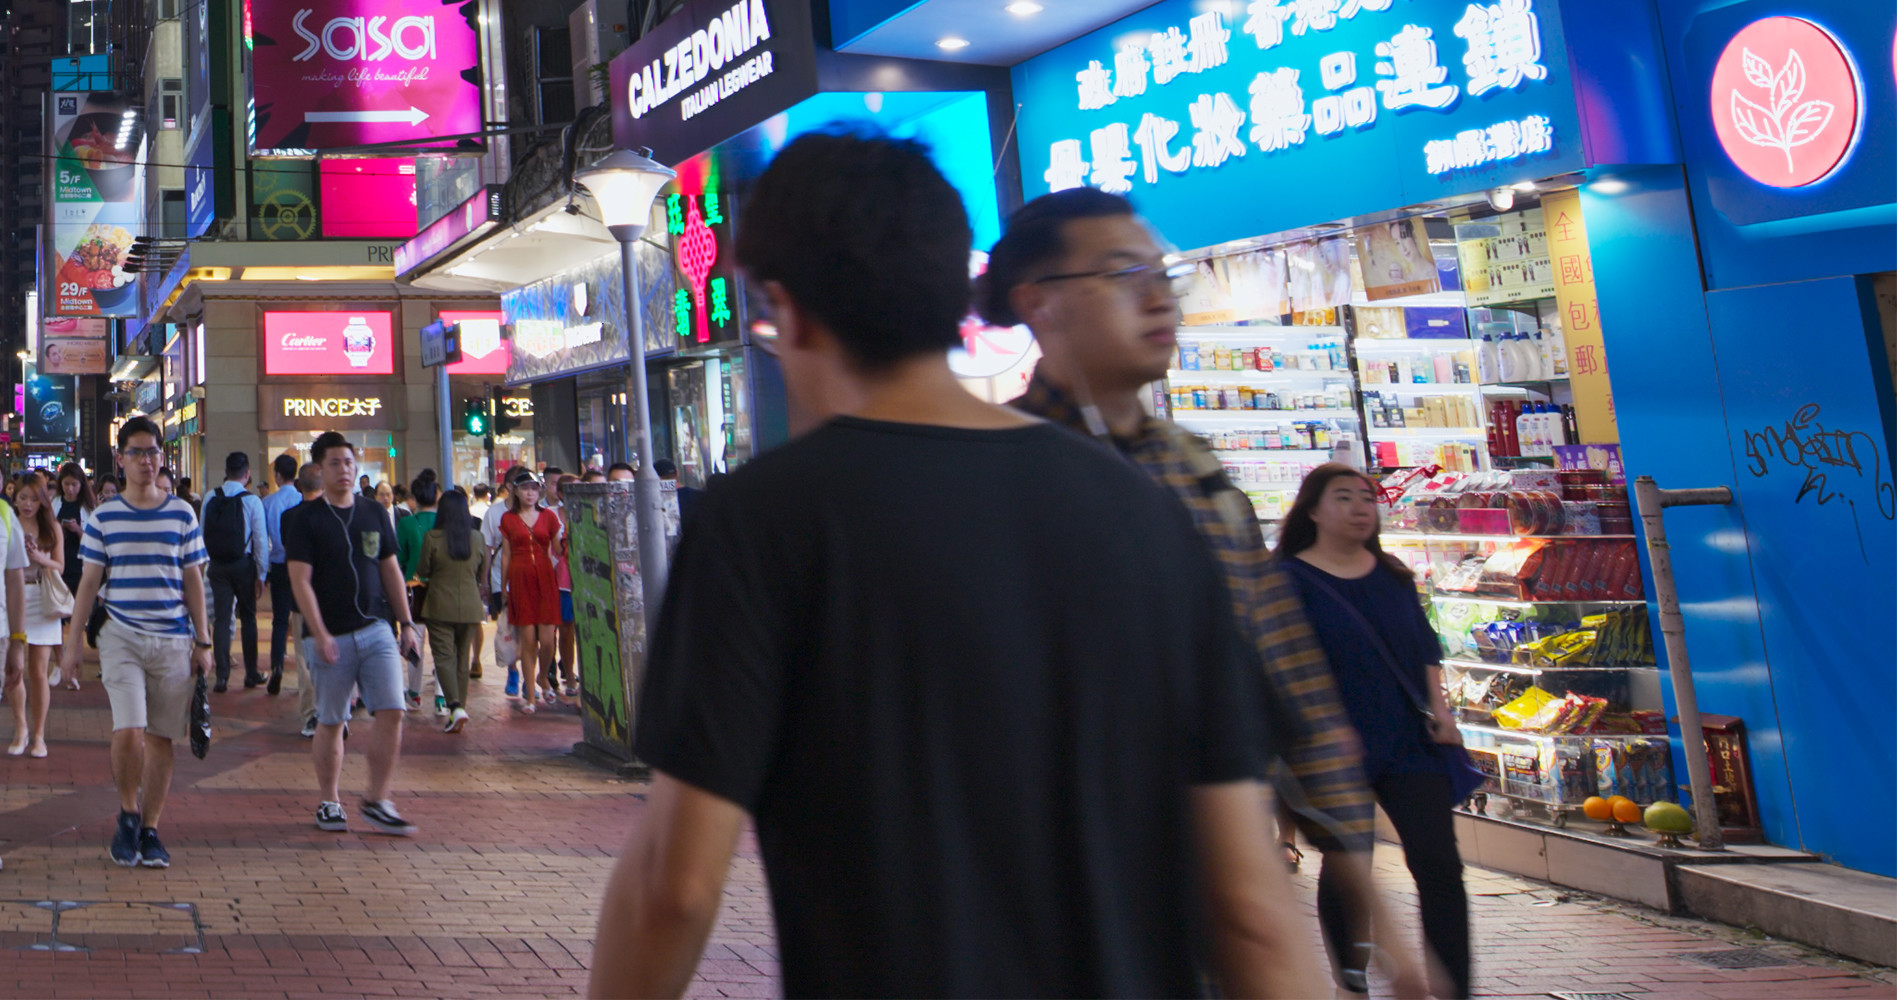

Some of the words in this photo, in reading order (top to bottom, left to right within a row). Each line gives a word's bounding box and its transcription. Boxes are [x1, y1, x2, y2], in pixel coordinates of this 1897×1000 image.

[301, 68, 345, 88] making
[347, 66, 371, 88] life
[374, 66, 429, 87] beautiful
[680, 81, 720, 121] ITALIAN
[718, 50, 773, 100] LEGWEAR
[59, 170, 81, 184] 5/F
[59, 186, 92, 194] Midtown
[60, 282, 88, 297] 29/F
[1553, 211, 1599, 376] 全國包郵
[60, 297, 93, 305] Midtown
[281, 332, 327, 347] Cartier
